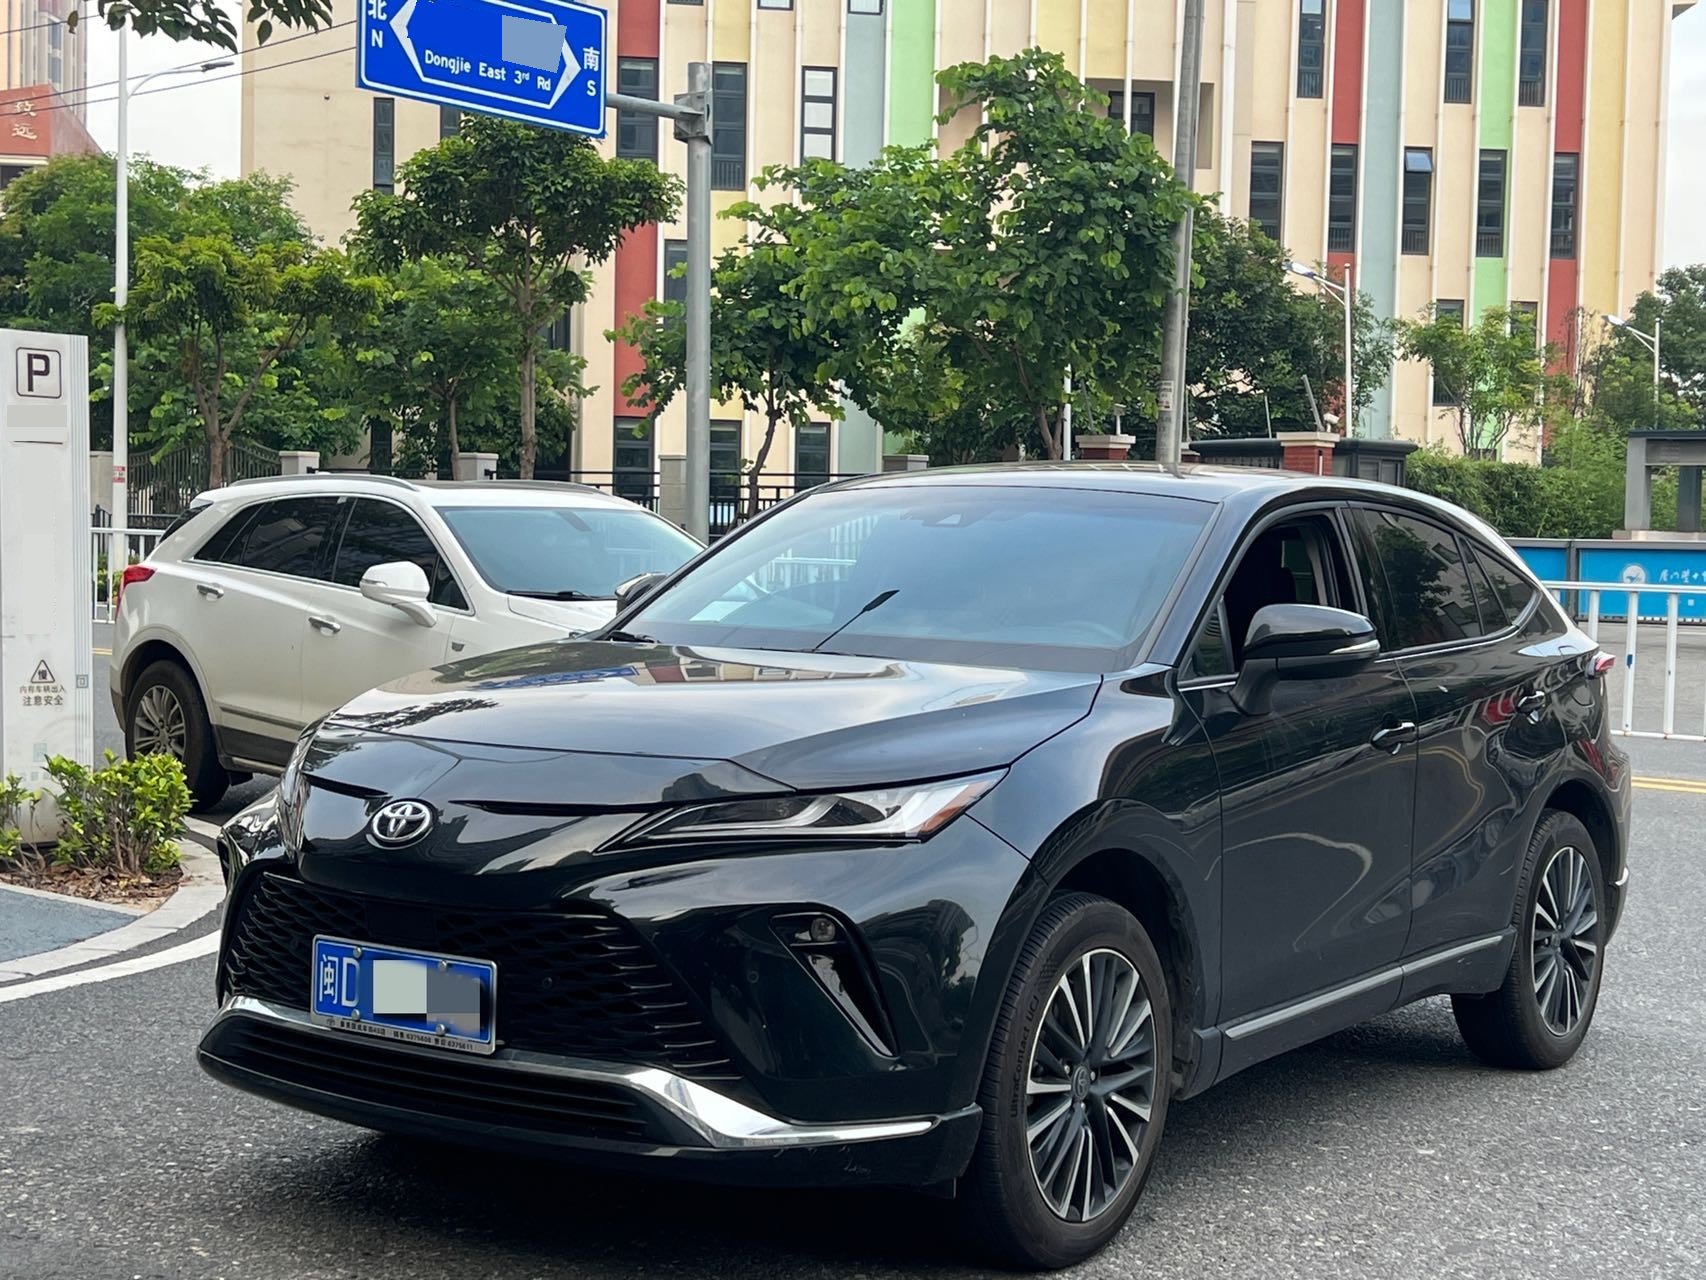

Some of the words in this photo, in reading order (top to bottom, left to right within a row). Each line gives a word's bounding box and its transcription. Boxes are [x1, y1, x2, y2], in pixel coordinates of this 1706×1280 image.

[368, 0, 388, 20] 北
[371, 28, 383, 48] N
[425, 49, 471, 75] Dongjie
[479, 63, 506, 81] East
[514, 70, 530, 84] 3rd
[537, 76, 551, 91] Rd
[583, 46, 600, 72] 南
[586, 80, 596, 96] S
[27, 353, 50, 392] P
[22, 695, 64, 706] 注意安全
[1011, 1027, 1030, 1117] UltraContact
